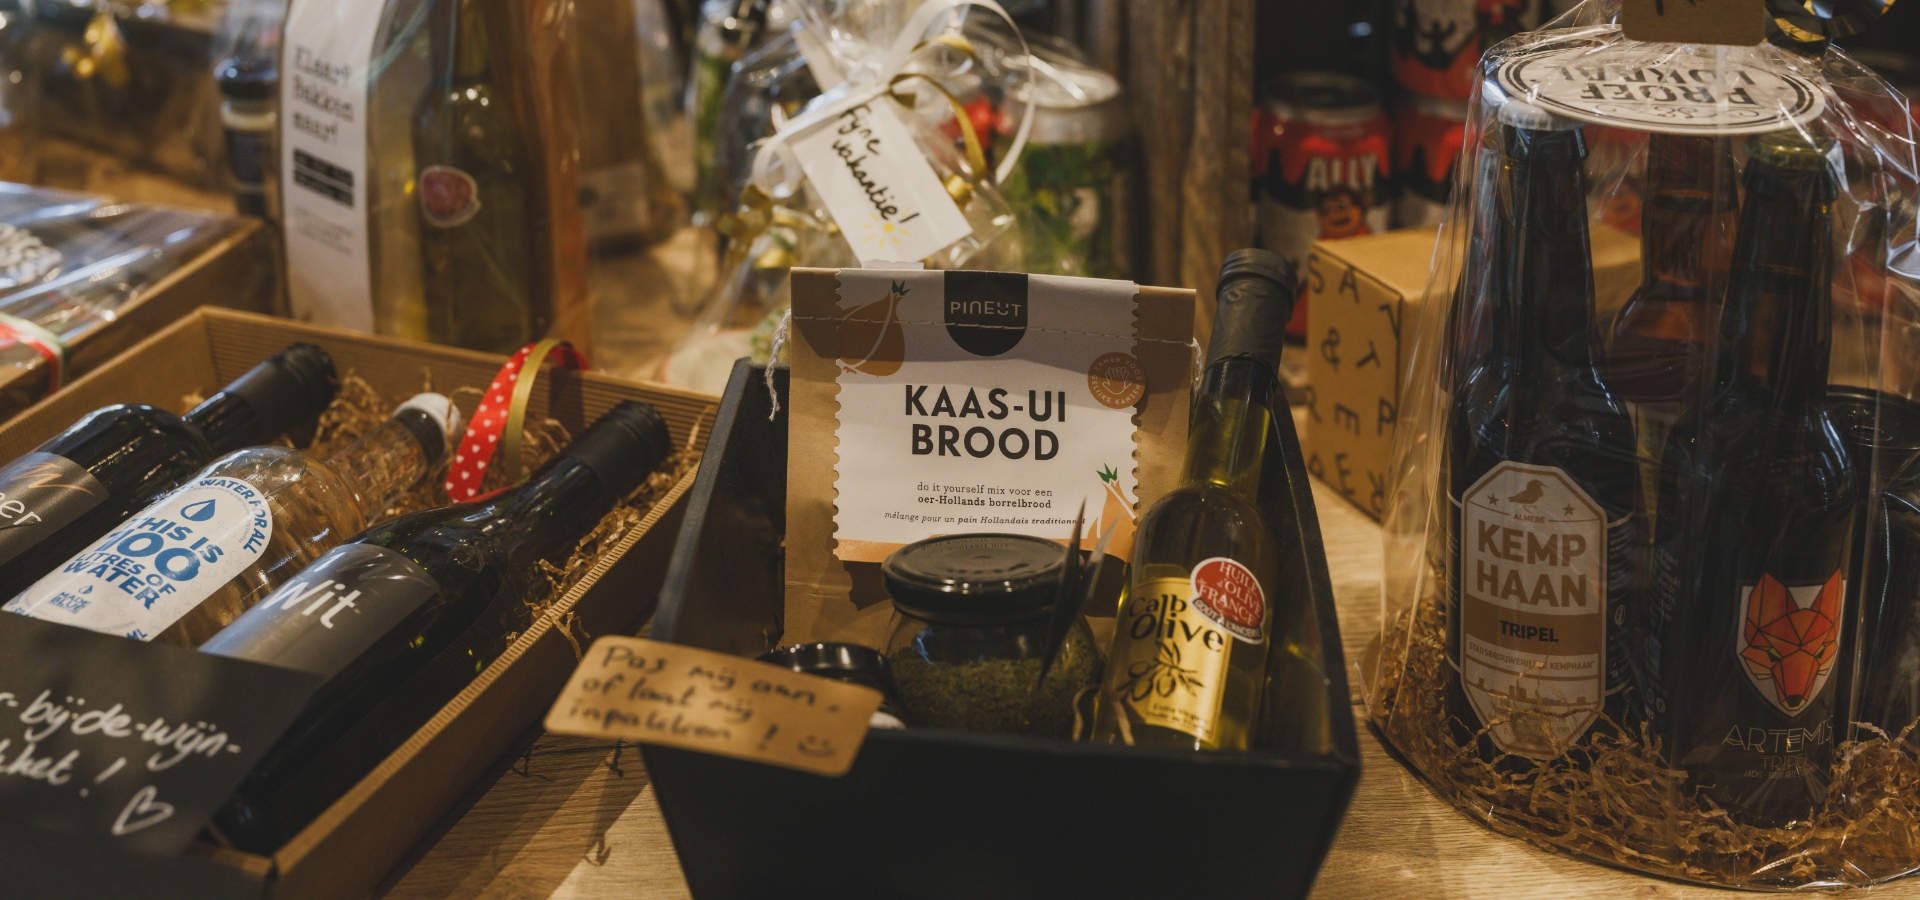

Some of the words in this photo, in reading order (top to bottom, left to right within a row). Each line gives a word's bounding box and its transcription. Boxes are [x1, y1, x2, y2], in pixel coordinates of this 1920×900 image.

[950, 300, 1022, 318] PINEUT
[905, 384, 1066, 423] KAAS-UI
[911, 423, 1060, 461] BROOD
[199, 480, 255, 500] WATER
[917, 481, 929, 492] do
[932, 482, 940, 493] it
[943, 483, 985, 497] yourself
[987, 485, 1006, 496] mix
[1008, 487, 1032, 497] voor
[1034, 488, 1053, 498] een
[917, 495, 986, 508] oer-Hollands
[988, 497, 1052, 509] borrelbrood
[248, 499, 268, 529] FOR
[921, 514, 942, 524] pour
[957, 515, 978, 525] pain
[980, 515, 1029, 525] Hollandais
[1031, 516, 1086, 526] traditionnl
[95, 528, 202, 582] 100
[189, 536, 225, 564] IS
[242, 527, 266, 554] ALL
[1477, 519, 1587, 568] KEMP
[63, 561, 163, 611] WATER
[75, 552, 147, 576] LITRES
[145, 573, 177, 596] OF
[1219, 561, 1258, 592] HUILE
[1476, 559, 1587, 609] HAAN
[259, 579, 362, 630] Wit
[1198, 584, 1256, 626] FRANCE
[1499, 620, 1560, 644] TRIPEL
